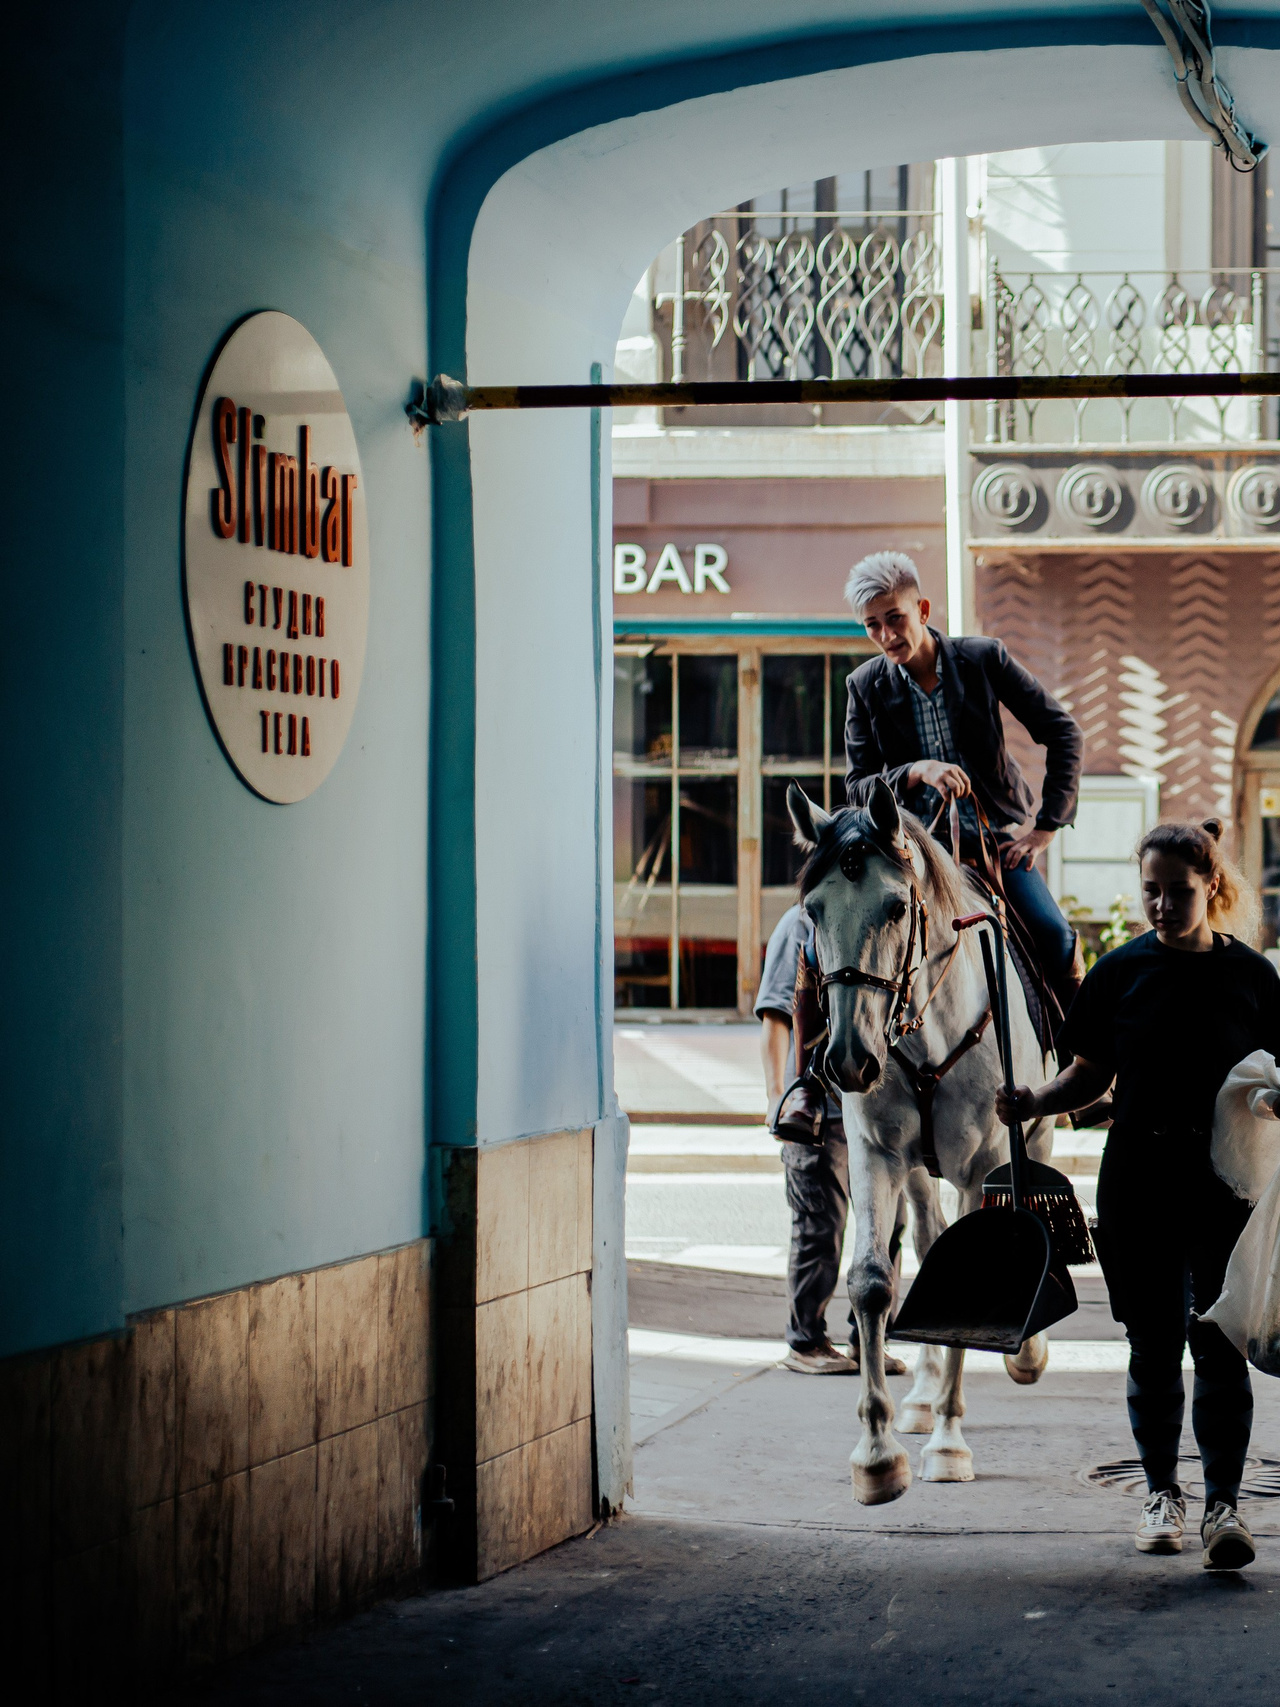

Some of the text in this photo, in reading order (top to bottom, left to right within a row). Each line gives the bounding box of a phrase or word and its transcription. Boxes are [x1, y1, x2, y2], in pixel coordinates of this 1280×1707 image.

[211, 397, 359, 570] Slimbar
[613, 542, 731, 594] BAR
[246, 581, 326, 641] СТУДИЯ
[223, 643, 341, 701] КРАСИВОГО
[260, 709, 313, 758] ТЕЛА
